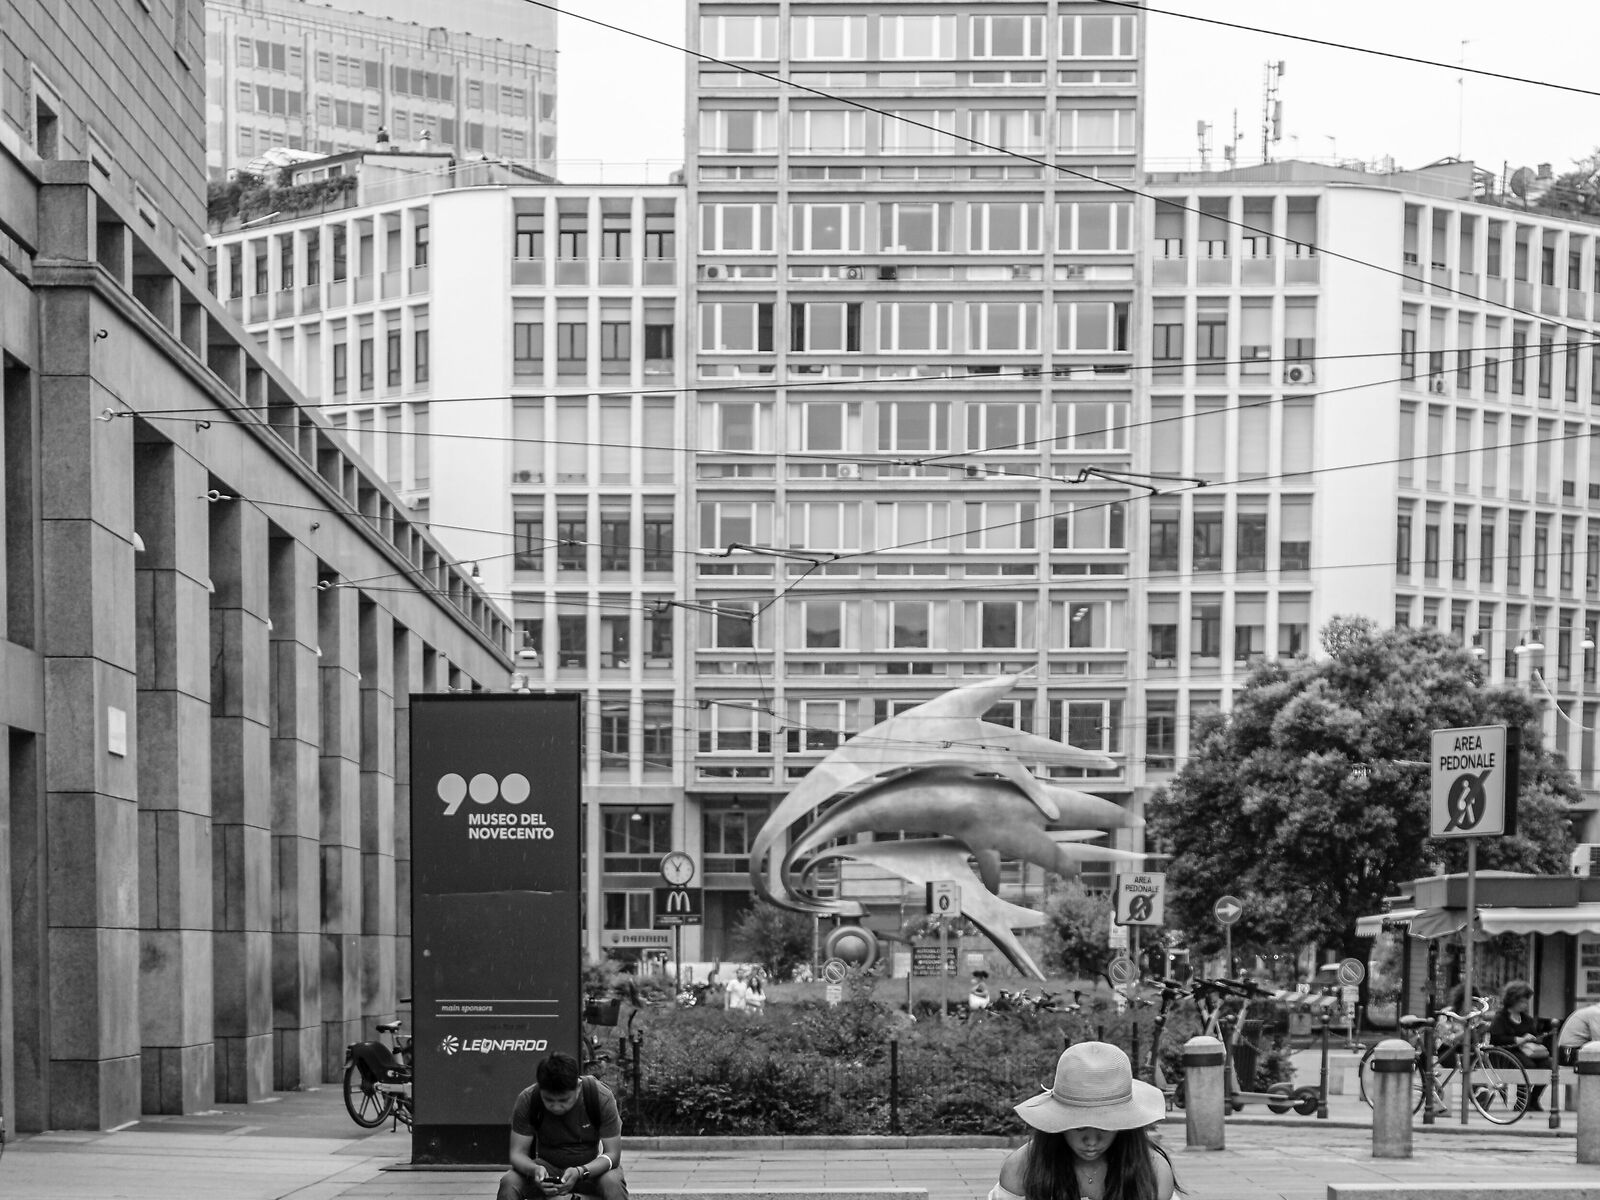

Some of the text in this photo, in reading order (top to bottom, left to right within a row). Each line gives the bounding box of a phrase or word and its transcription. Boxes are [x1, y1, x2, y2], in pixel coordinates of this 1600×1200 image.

[1454, 735, 1482, 751] AREA
[1440, 753, 1496, 771] PEDONALE
[437, 772, 531, 816] 900
[468, 813, 547, 826] MUSEO DEL
[468, 827, 555, 840] NOVECENTO
[1134, 876, 1152, 884] AREA
[1125, 884, 1160, 893] PEDONALE
[441, 1004, 493, 1014] main sponsors
[462, 1039, 548, 1052] LEONARDO
